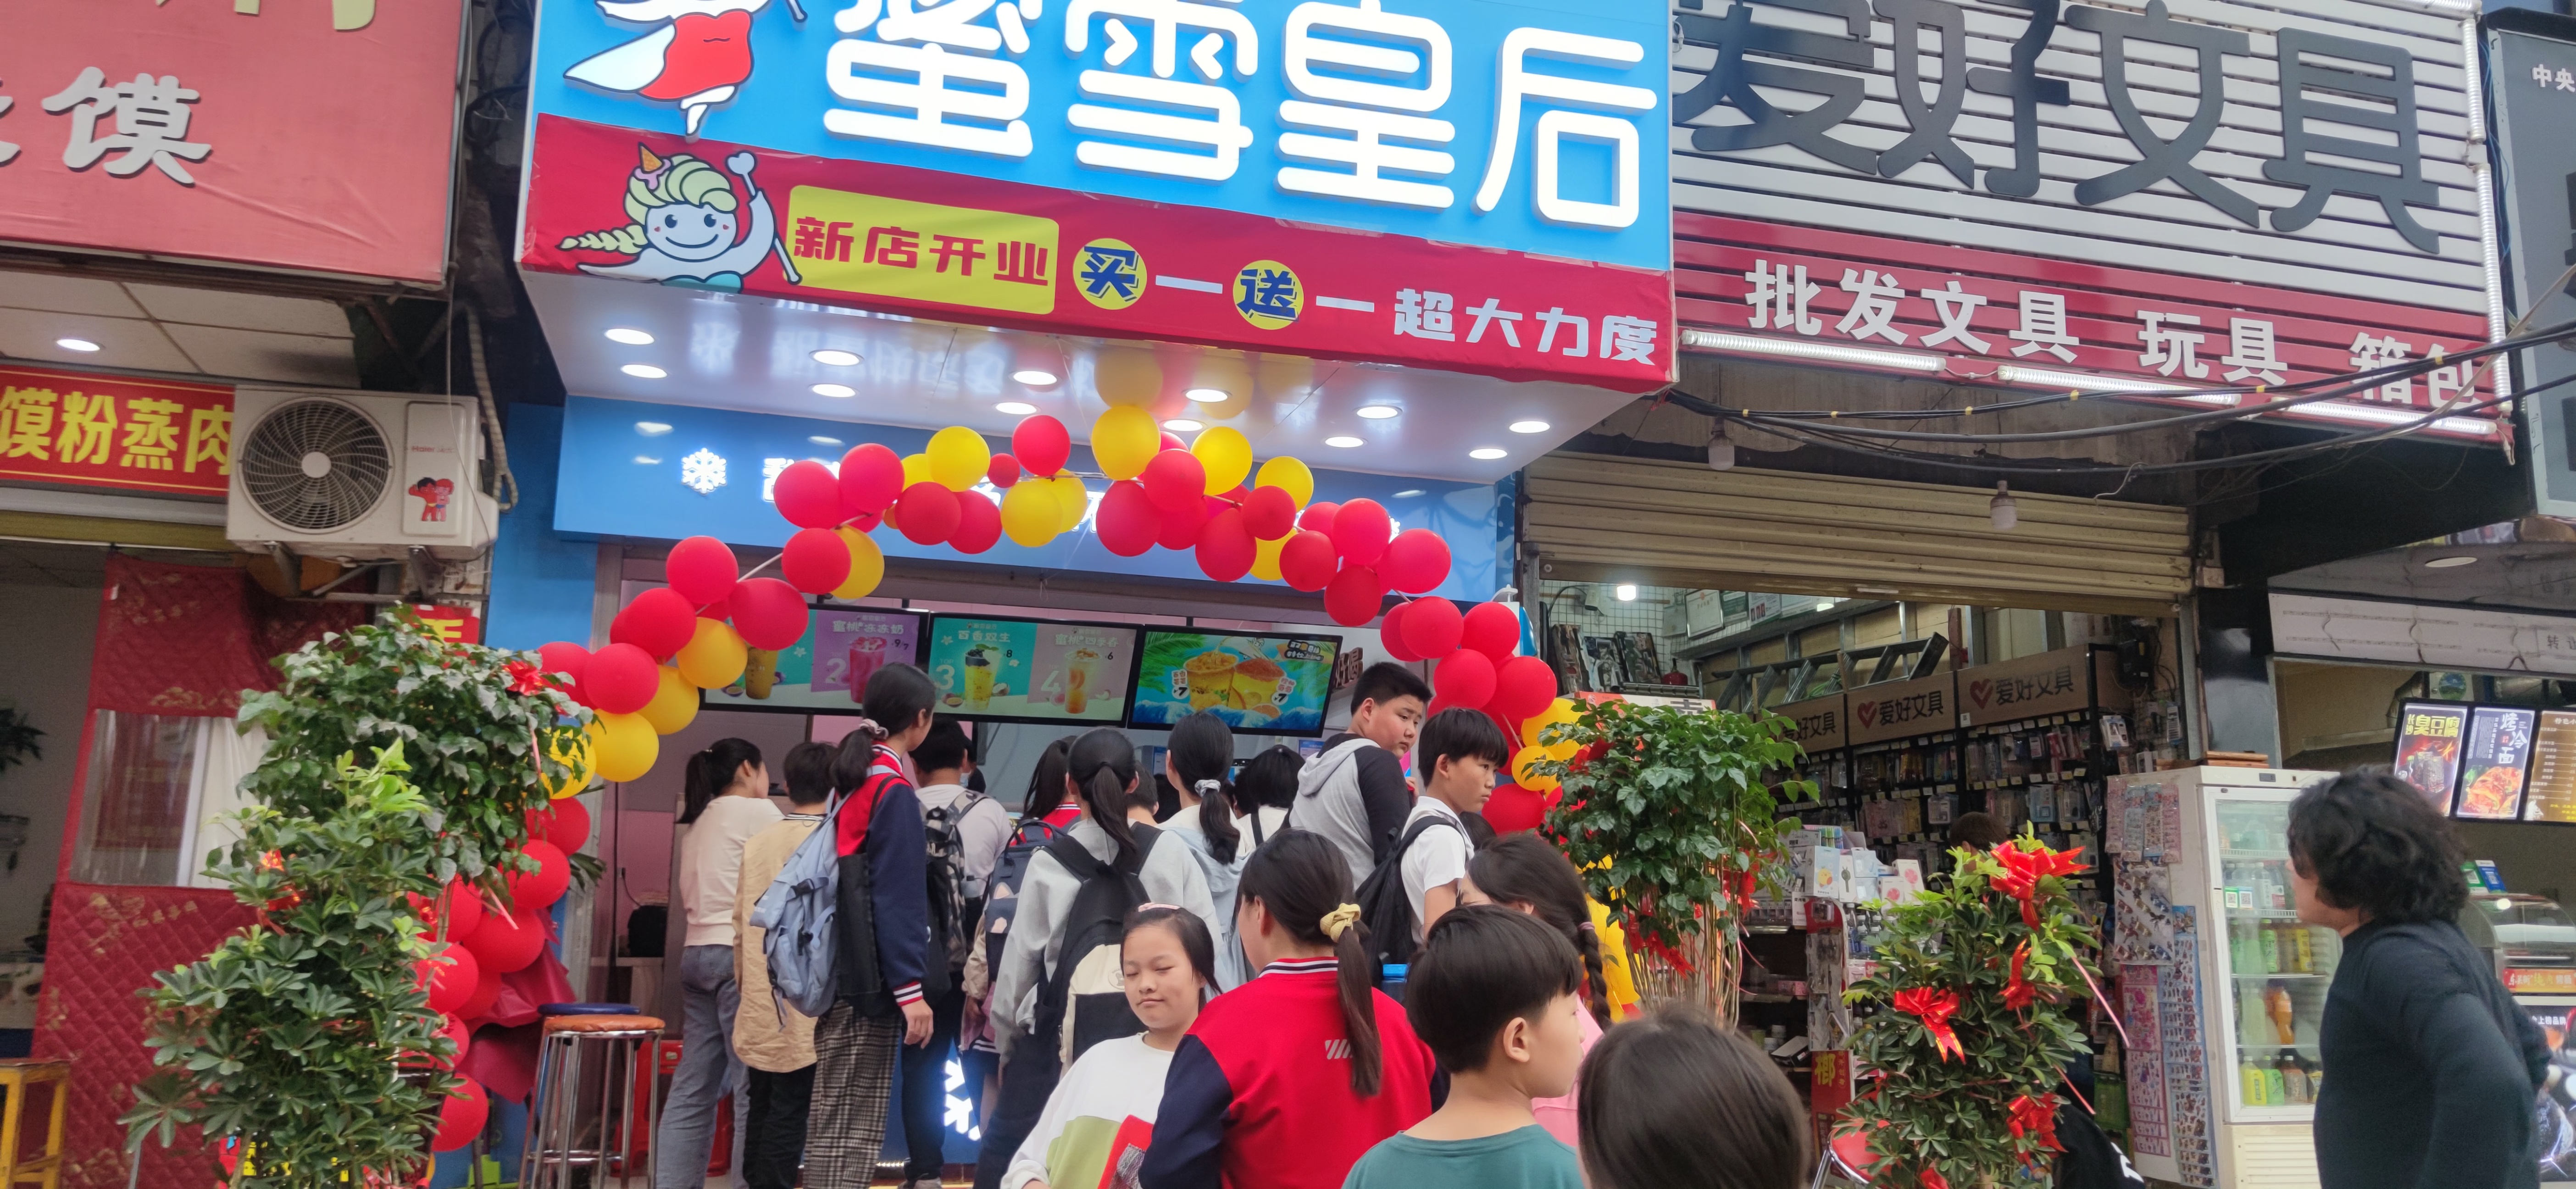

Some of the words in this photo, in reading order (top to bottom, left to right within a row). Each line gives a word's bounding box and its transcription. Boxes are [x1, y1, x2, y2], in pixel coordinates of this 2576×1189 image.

[2532, 64, 2575, 92] 中央
[823, 0, 1657, 228] 蜜雪皇后
[794, 216, 1049, 287] 新店开业
[1079, 246, 1375, 322] 买一送一
[1394, 288, 1658, 366] 超大力度
[1745, 259, 2079, 363] 批发文具
[2137, 310, 2287, 386] 玩具
[2349, 332, 2482, 411] 箱包
[0, 385, 235, 475] 馍粉蒸肉
[958, 630, 1010, 642] 百香双生
[826, 658, 846, 683] 2
[934, 665, 955, 690] 3
[1041, 670, 1061, 693] 4
[1995, 665, 2073, 706] 爱好文具
[1879, 691, 1943, 725] 爱好文具
[2414, 714, 2461, 738] 臭豆腐
